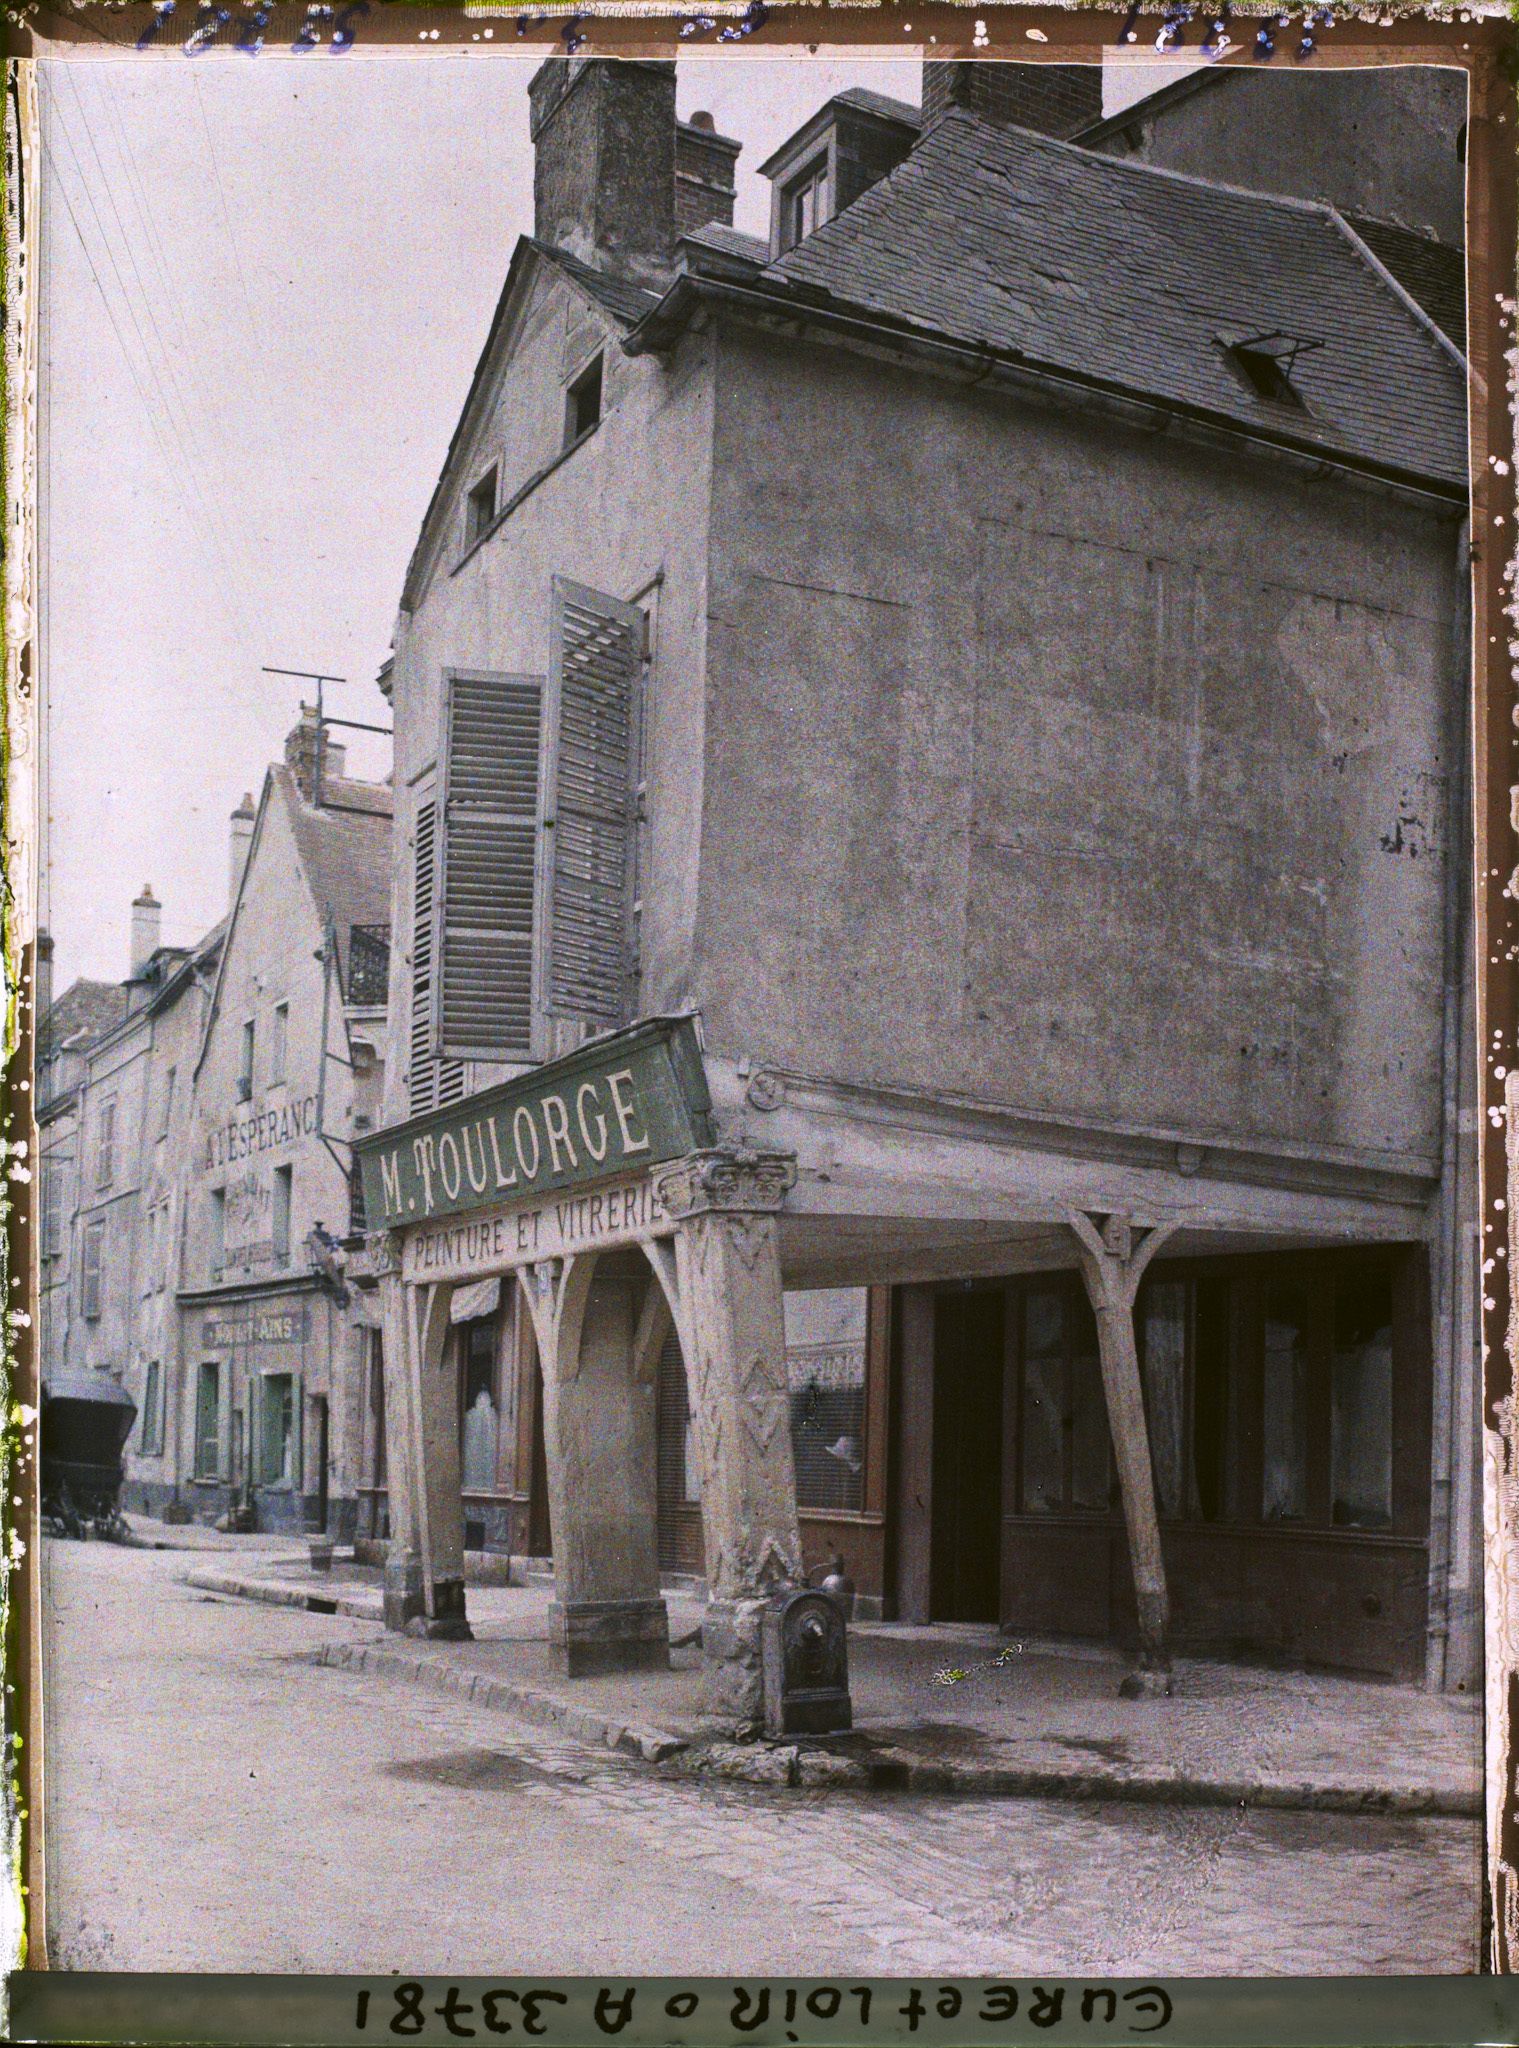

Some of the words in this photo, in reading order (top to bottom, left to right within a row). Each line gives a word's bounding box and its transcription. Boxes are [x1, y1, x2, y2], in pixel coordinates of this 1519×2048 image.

[413, 1068, 650, 1217] TOULORGE
[413, 1218, 505, 1271] PEINTURE
[516, 1210, 542, 1250] ET
[555, 1182, 663, 1240] VITRERIE
[355, 1982, 568, 2038] 33781
[594, 1987, 636, 2035] A
[899, 1985, 962, 2032] et
[979, 1985, 1173, 2033] EURE
